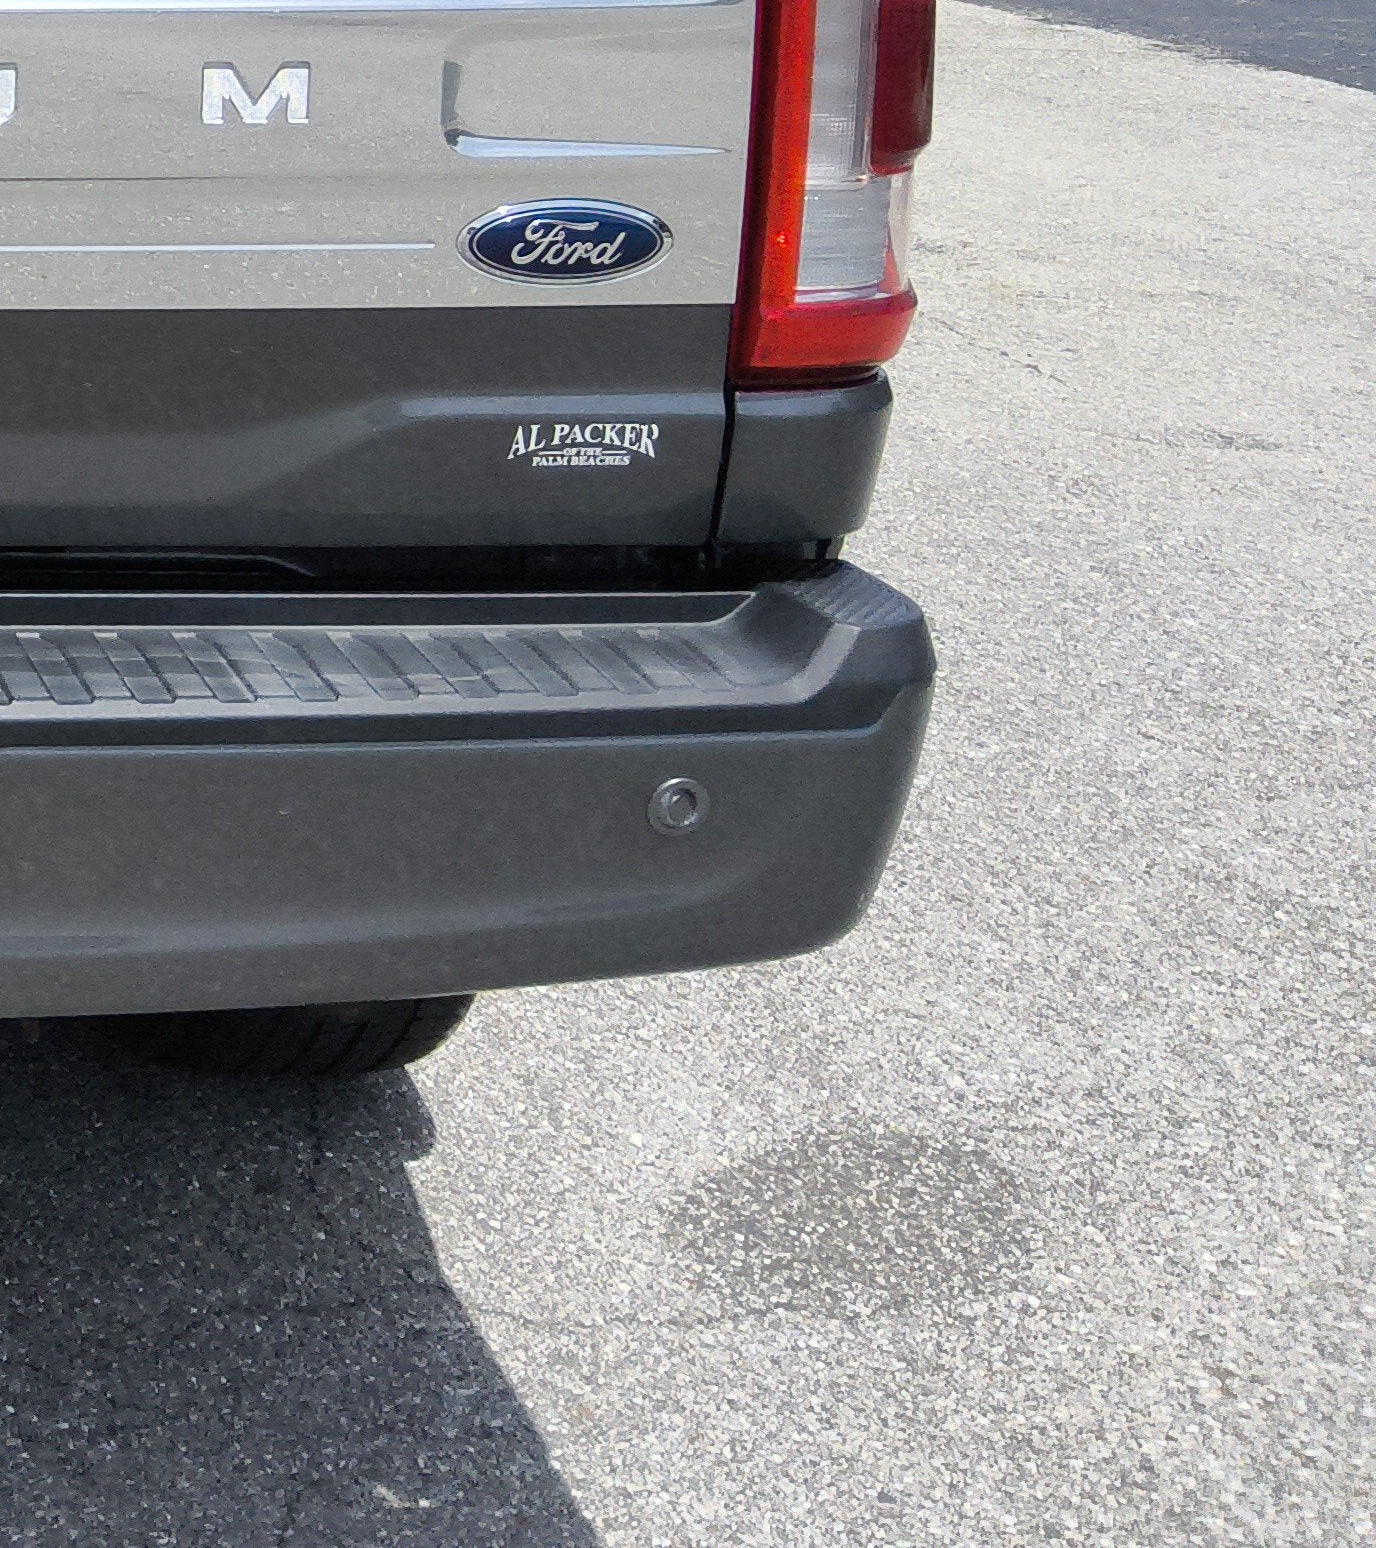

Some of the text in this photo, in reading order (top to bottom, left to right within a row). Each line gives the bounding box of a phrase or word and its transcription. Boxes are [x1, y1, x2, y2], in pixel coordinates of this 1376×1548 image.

[510, 218, 626, 266] Ford
[506, 423, 660, 460] AL PACKER
[532, 455, 631, 466] PALM BEACHES
